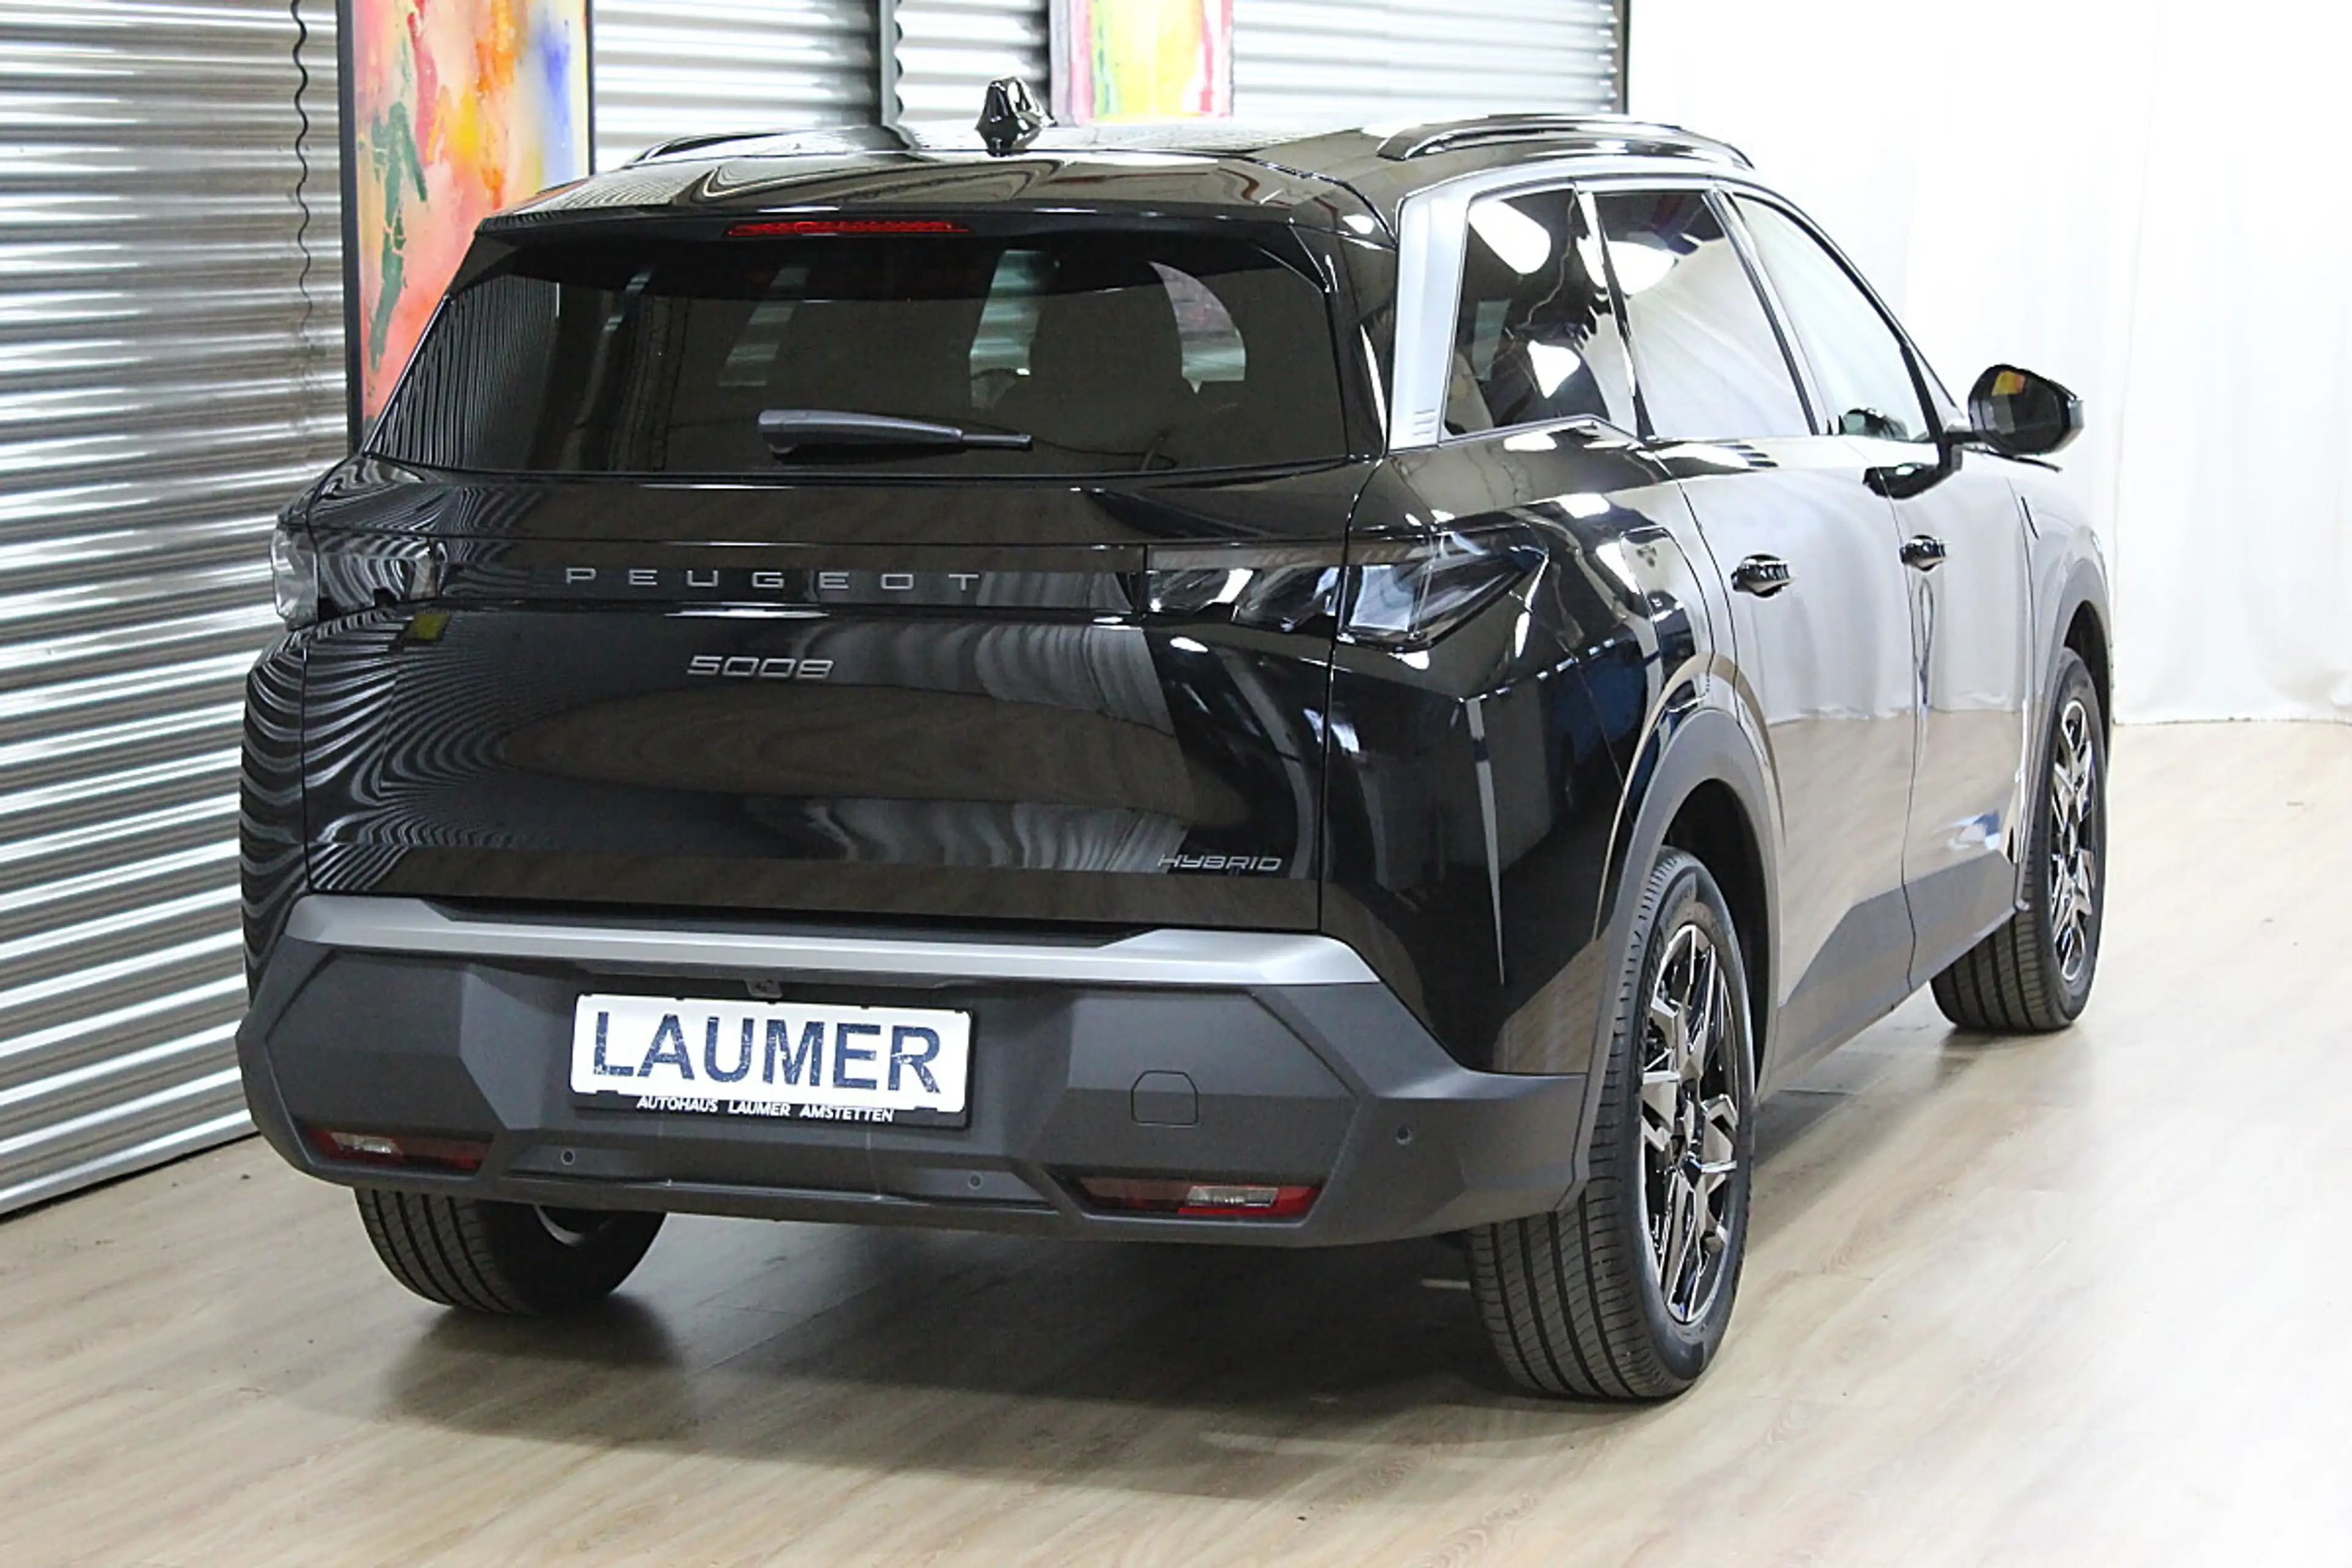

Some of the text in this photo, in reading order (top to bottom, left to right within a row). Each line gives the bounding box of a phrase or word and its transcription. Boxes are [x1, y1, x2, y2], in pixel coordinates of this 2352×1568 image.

[566, 568, 979, 590] PEUGEOT
[687, 655, 834, 678] 5008
[1158, 854, 1282, 871] HYBRID
[592, 1011, 941, 1094] LAUMER
[636, 1095, 894, 1123] AUTOHAUS LAUMER AMSTETTEN
